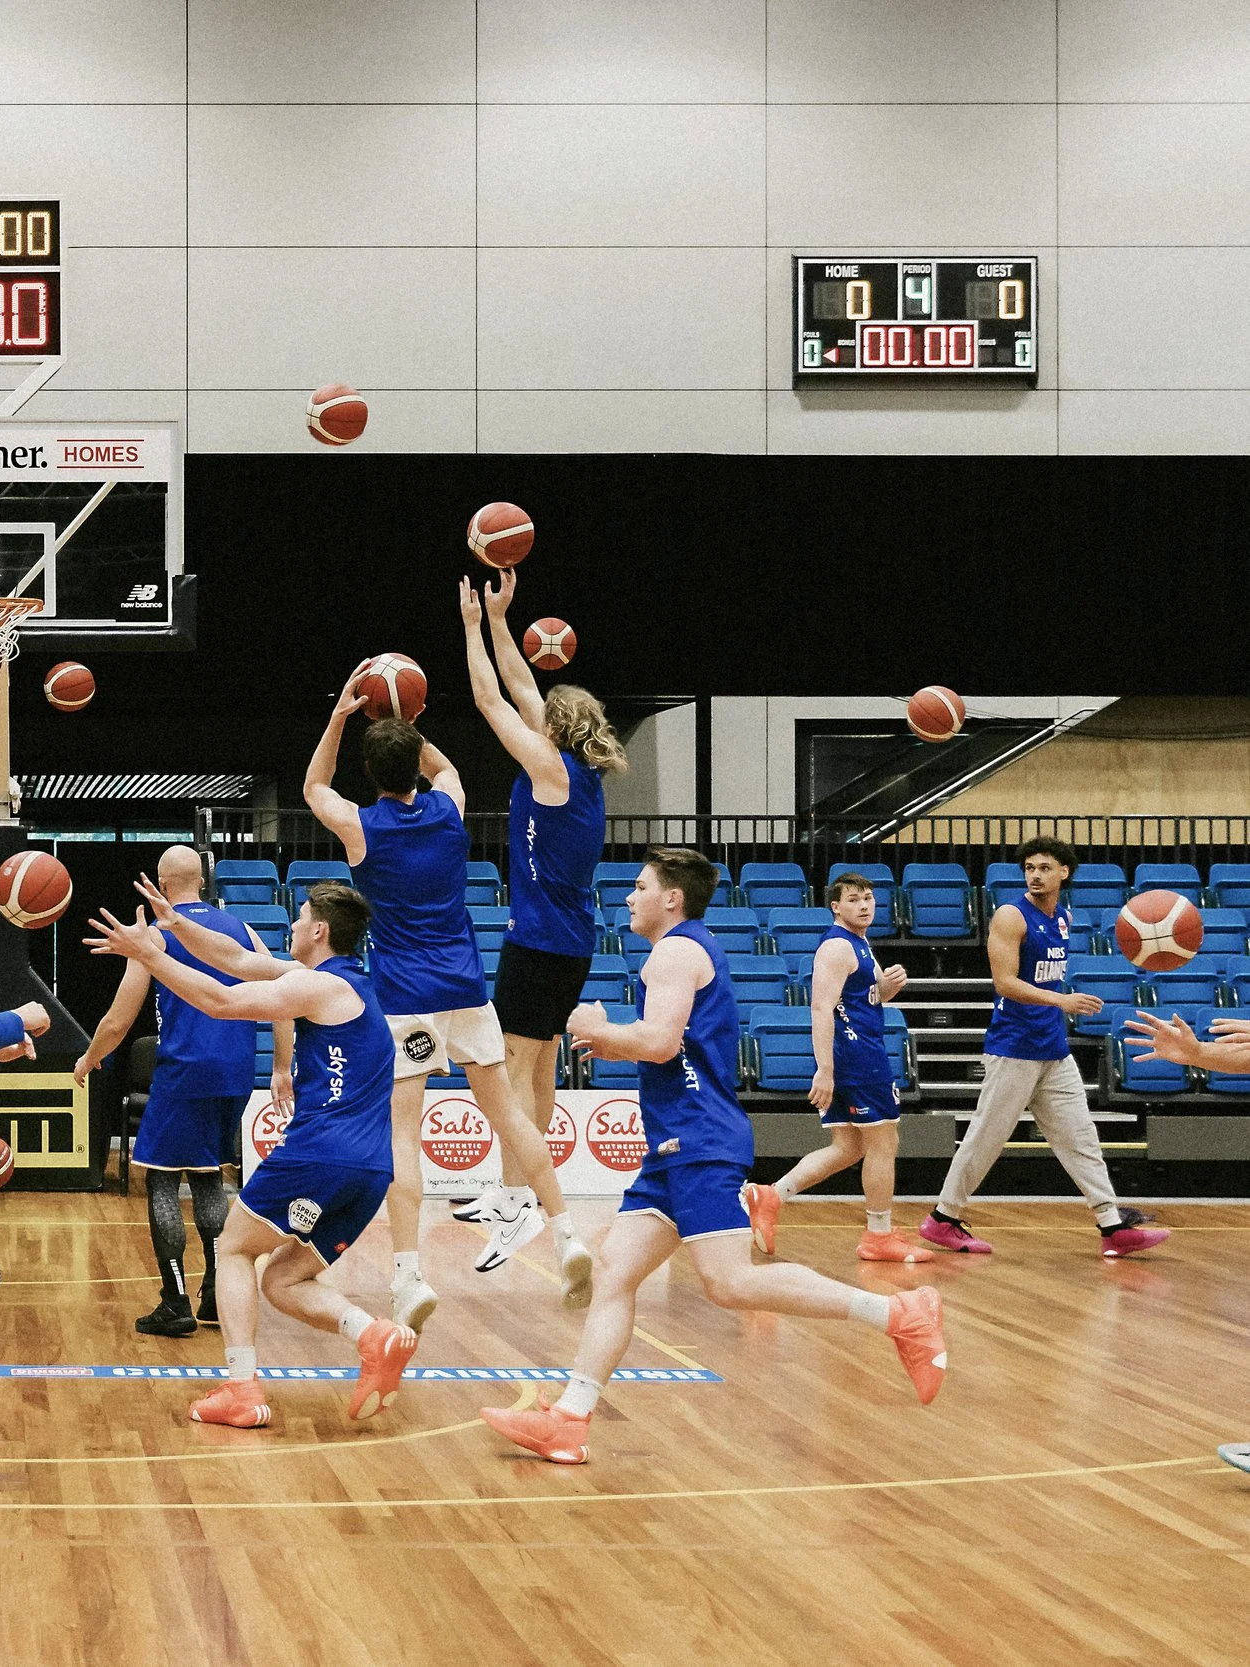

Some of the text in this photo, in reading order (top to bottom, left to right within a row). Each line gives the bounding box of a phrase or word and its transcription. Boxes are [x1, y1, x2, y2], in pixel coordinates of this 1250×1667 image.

[825, 265, 859, 278] HOME
[903, 265, 931, 274] PERIOD
[977, 265, 1013, 278] GUEST
[846, 280, 871, 320] 0
[905, 276, 931, 314] 4
[998, 280, 1023, 320] 0
[804, 339, 821, 367] 0
[1015, 339, 1031, 367] 0
[64, 446, 139, 463] HOMES
[135, 601, 163, 609] balance
[1047, 947, 1065, 959] NBS
[407, 1036, 429, 1049] SPRIG
[429, 1111, 484, 1135] Sal's
[596, 1111, 645, 1136] Sal
[296, 1204, 318, 1220] SPRIG
